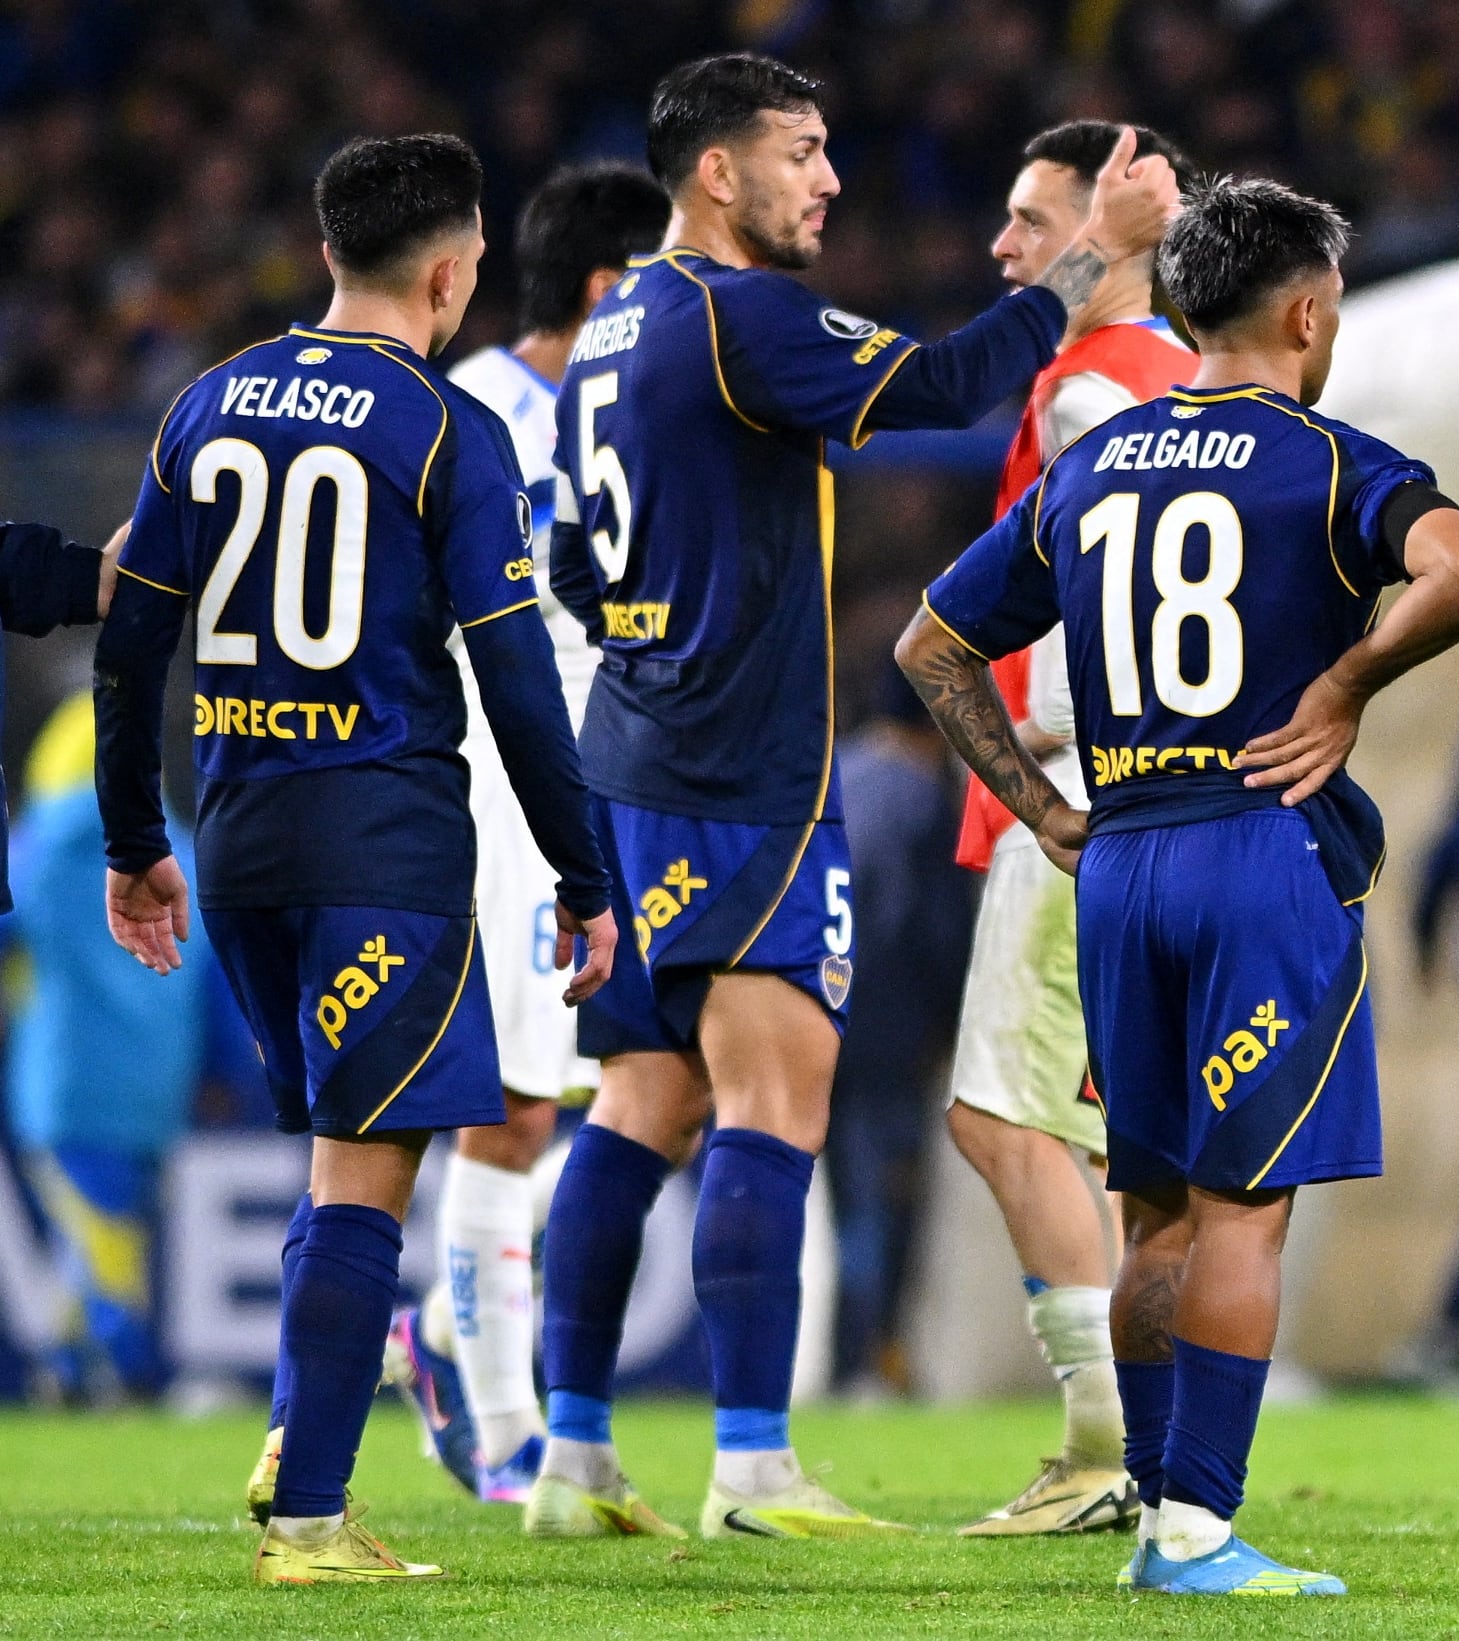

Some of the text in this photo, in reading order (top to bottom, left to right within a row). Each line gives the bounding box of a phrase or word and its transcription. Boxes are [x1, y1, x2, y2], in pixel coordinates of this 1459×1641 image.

[219, 375, 376, 429] VELASCO
[1093, 428, 1257, 474] DELGADO
[579, 370, 632, 584] 5
[189, 437, 370, 671] 20
[1079, 490, 1244, 718] 18
[194, 693, 361, 741] DIRECTV
[823, 866, 853, 956] 5
[316, 934, 406, 1050] pax
[1201, 999, 1290, 1112] pax
